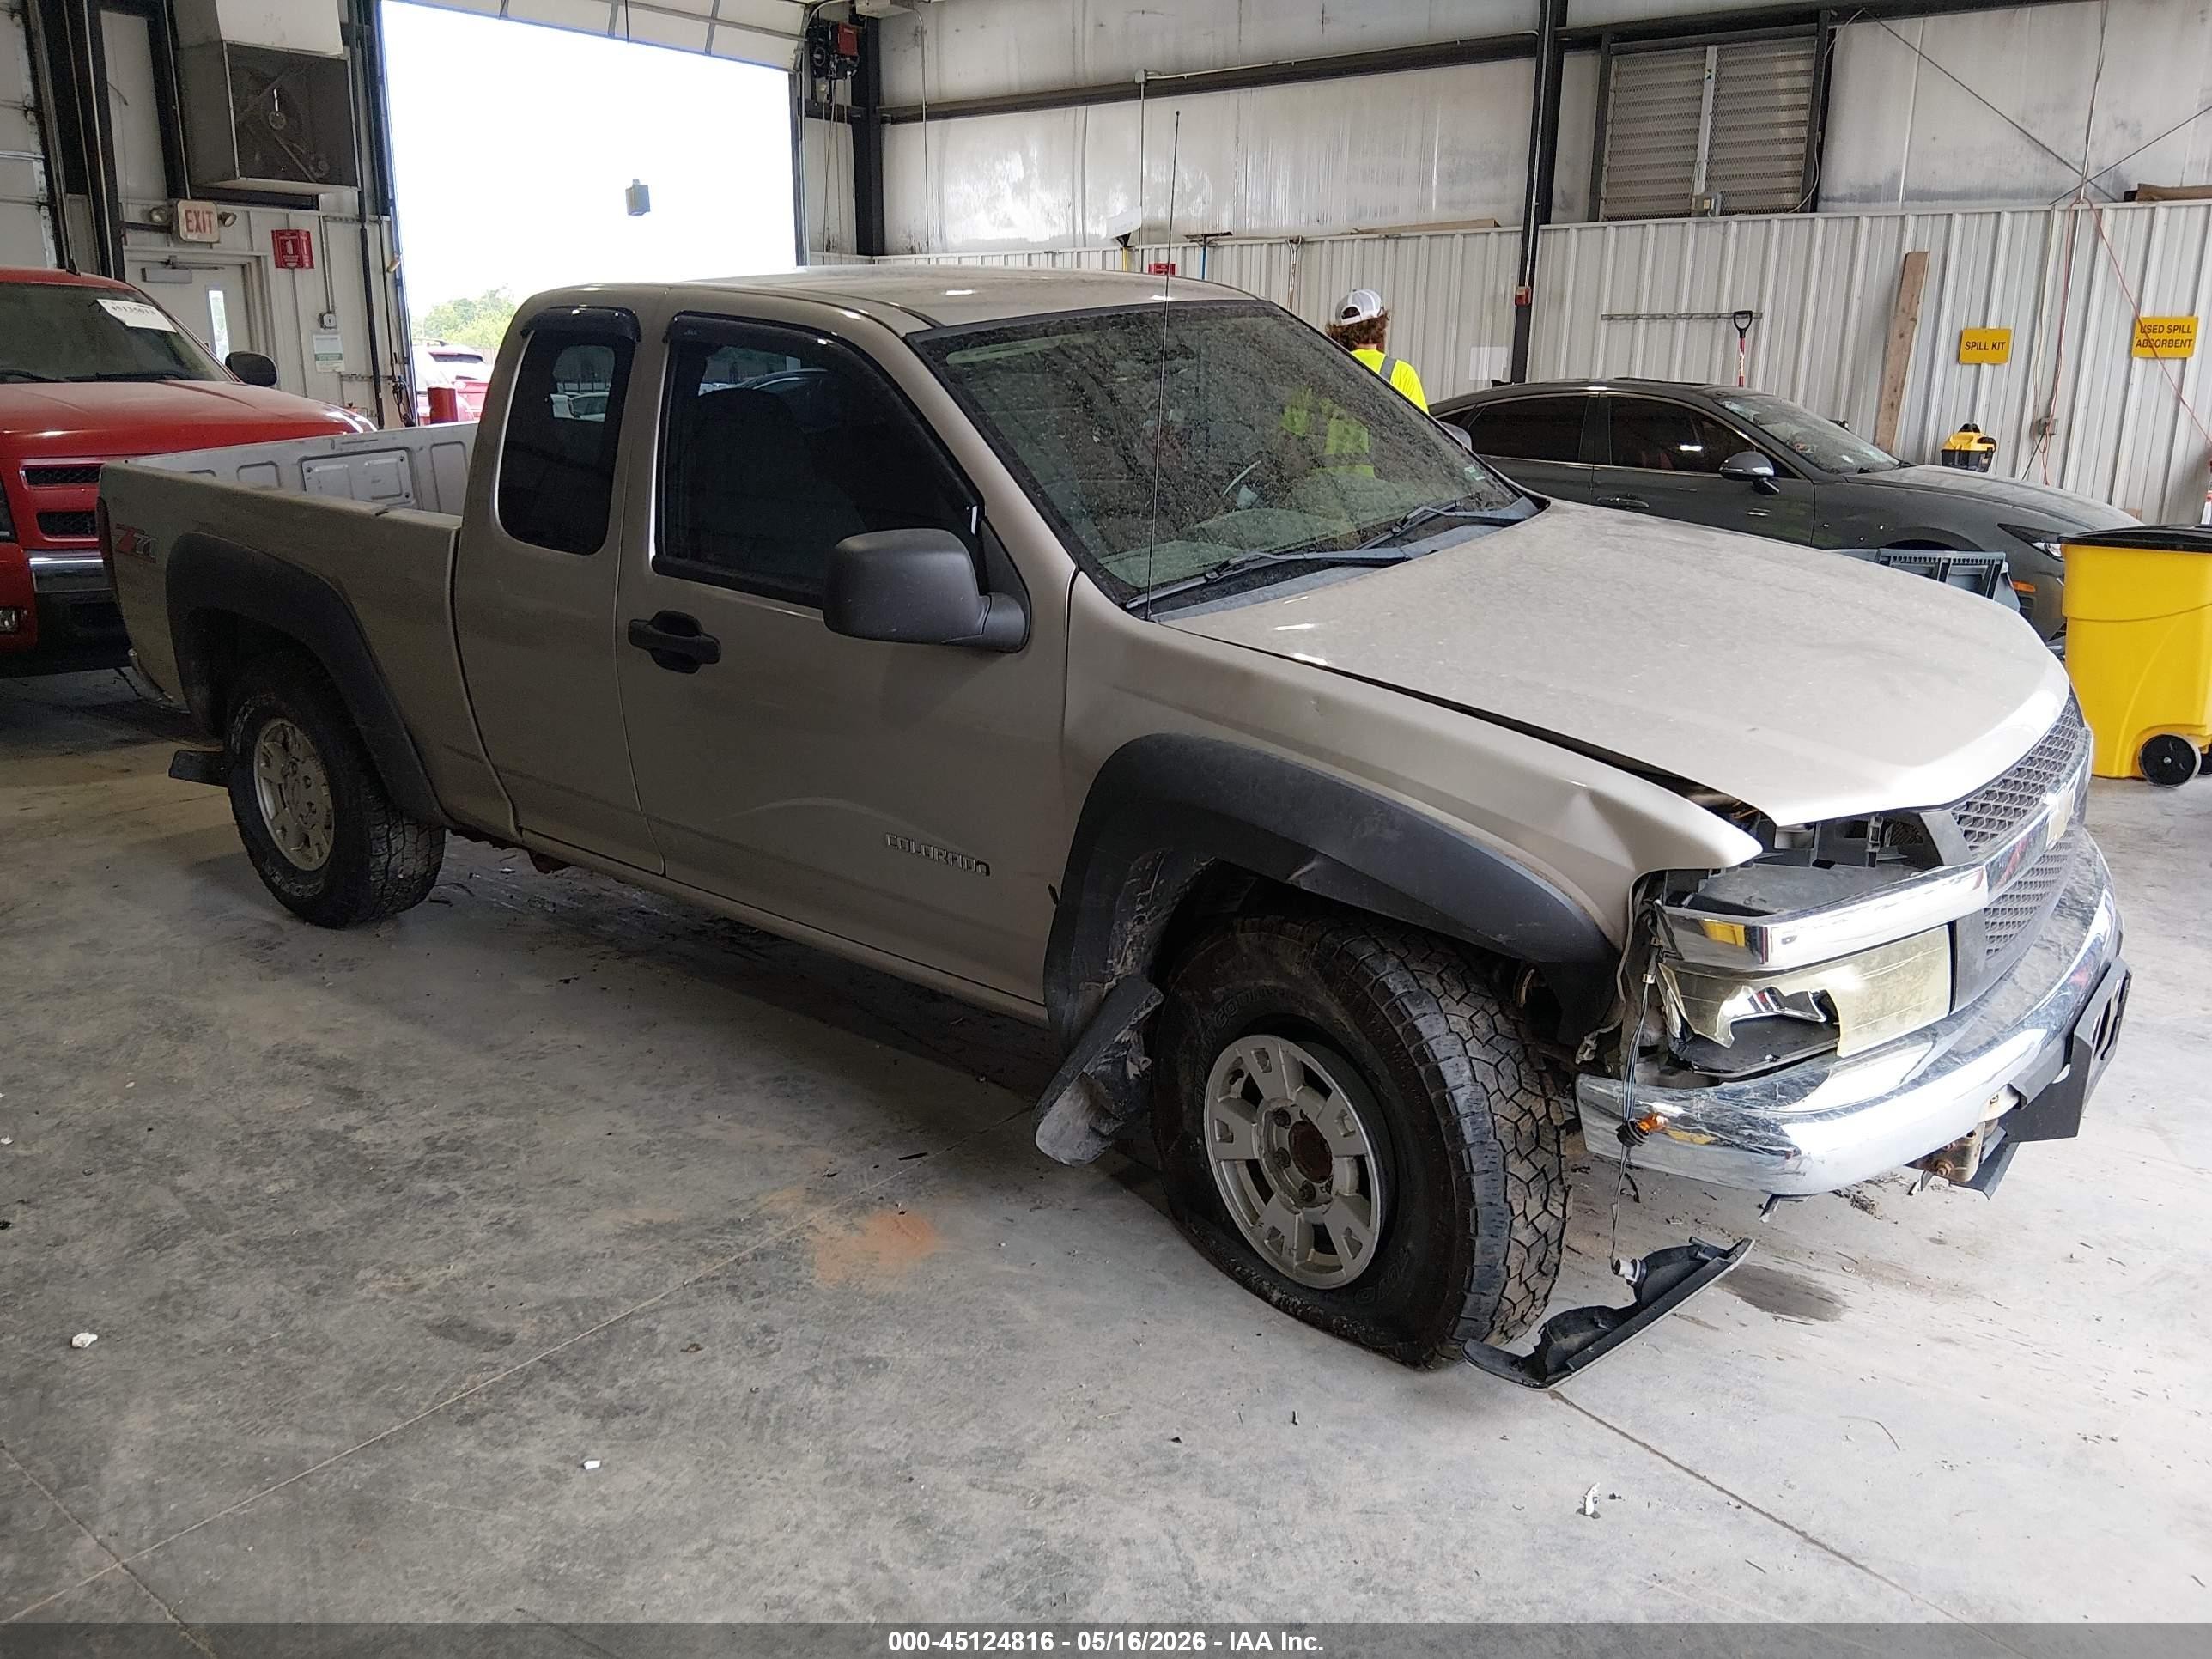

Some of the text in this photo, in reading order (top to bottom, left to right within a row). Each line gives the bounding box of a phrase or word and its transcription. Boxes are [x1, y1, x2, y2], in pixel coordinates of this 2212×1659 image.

[185, 210, 213, 234] EXIT
[2140, 325, 2192, 334] USED SPILL
[1965, 341, 2006, 350] SPILL KIT
[2136, 338, 2192, 349] ABSORBENT
[884, 832, 990, 876] COLORADO
